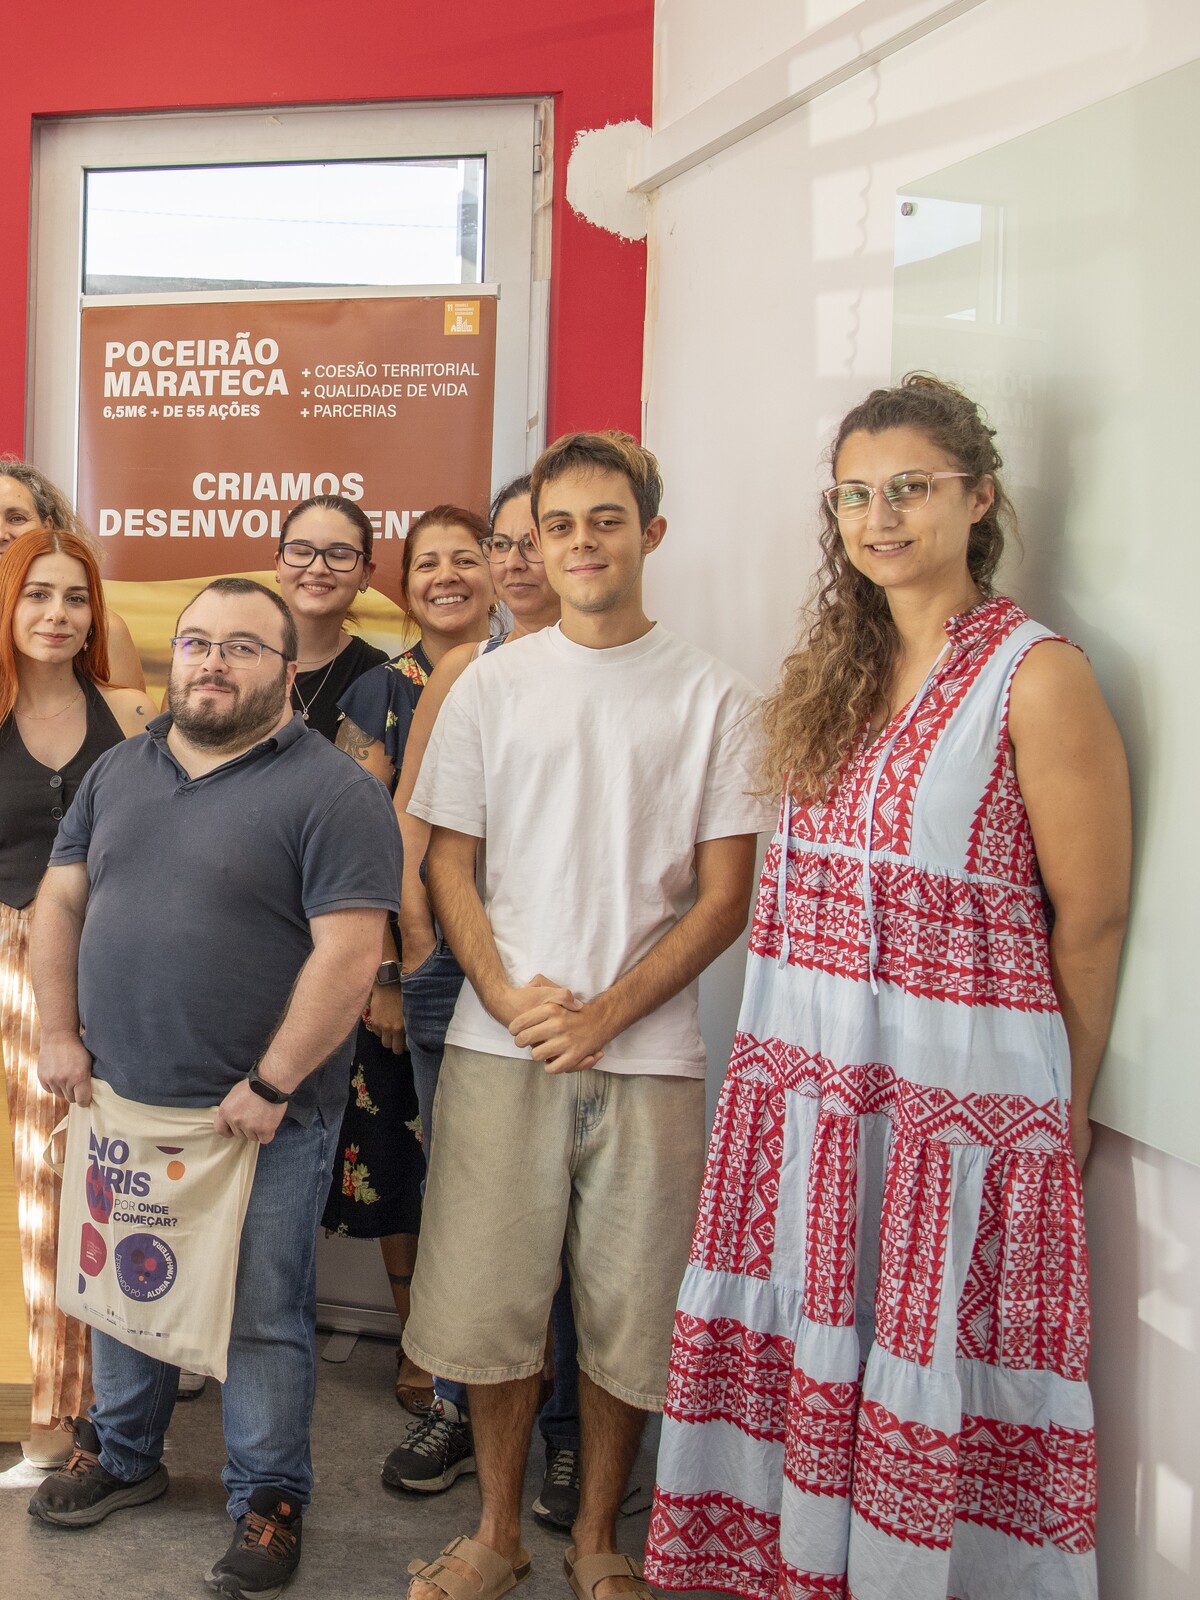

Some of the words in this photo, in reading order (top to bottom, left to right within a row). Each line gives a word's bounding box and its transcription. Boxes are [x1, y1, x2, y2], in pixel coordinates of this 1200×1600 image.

[104, 331, 280, 368] POCEIRÃO
[314, 361, 378, 378] COESÃO
[381, 363, 480, 377] TERRITORIAL
[103, 368, 290, 398] MARATECA
[313, 384, 402, 399] QUALIDADE
[406, 383, 428, 397] DE
[431, 383, 469, 397] VIDA
[102, 404, 147, 420] 6,5M€
[163, 405, 183, 417] DE
[186, 405, 205, 417] 55
[208, 401, 261, 420] AÇÕES
[313, 404, 397, 418] PARCERIAS
[191, 472, 365, 502] CRIAMOS
[99, 508, 427, 540] DESENVOLEN
[114, 1198, 136, 1211] POR
[137, 1202, 169, 1215] ONDE
[113, 1212, 178, 1228] COMEÇAR?
[152, 1239, 174, 1280] VINHATEIRA
[146, 1280, 171, 1299] ALDEIA
